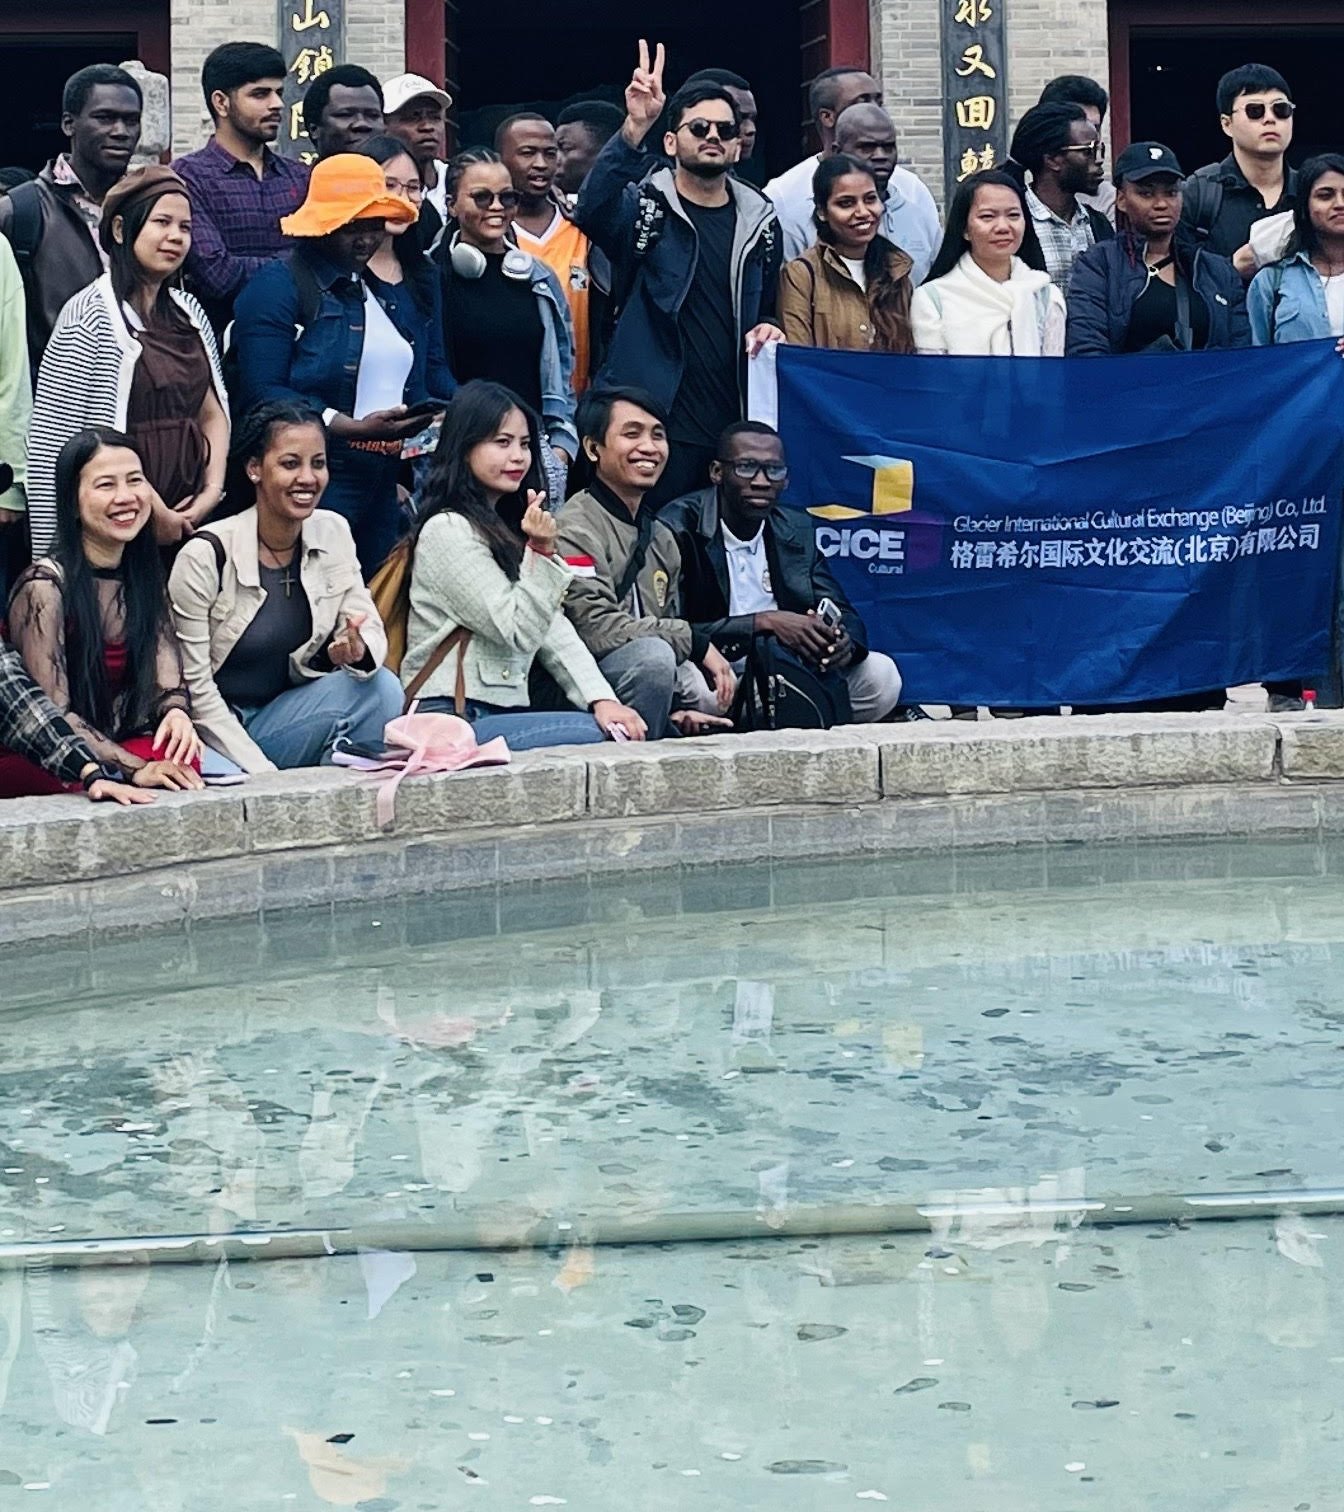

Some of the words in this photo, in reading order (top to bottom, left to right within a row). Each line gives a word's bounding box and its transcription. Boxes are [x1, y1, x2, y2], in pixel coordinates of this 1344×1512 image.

[1005, 511, 1089, 533] International
[1091, 508, 1145, 529] Cultural
[1147, 506, 1217, 531] Exchange
[815, 526, 905, 560] CICE
